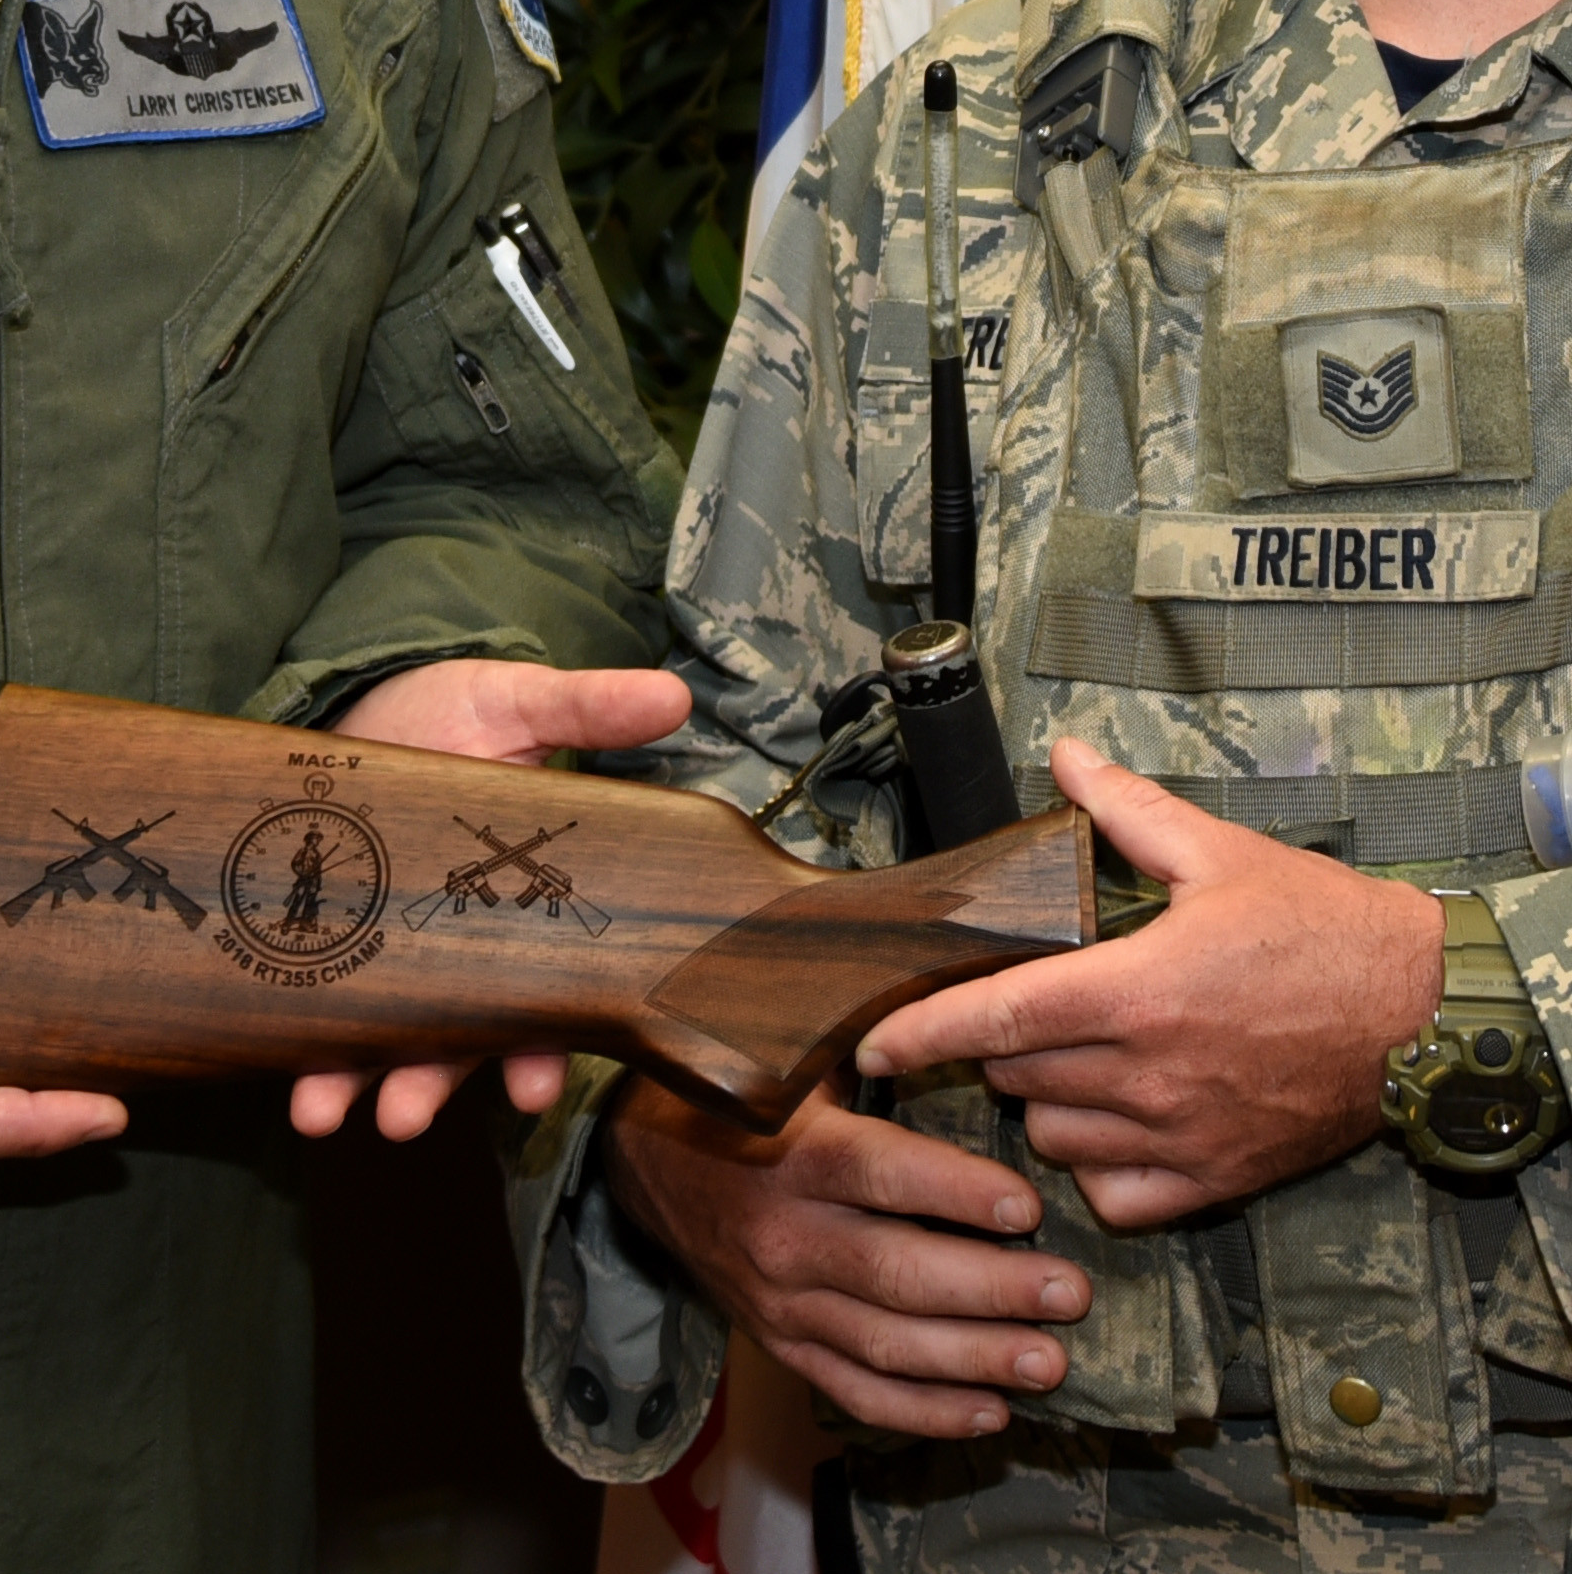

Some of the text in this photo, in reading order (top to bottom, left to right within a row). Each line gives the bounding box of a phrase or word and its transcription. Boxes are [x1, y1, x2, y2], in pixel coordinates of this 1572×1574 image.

[127, 83, 305, 117] LARRY CHRISTENSEN
[1232, 527, 1436, 591] TREIBER
[287, 752, 362, 770] MAC-V
[213, 928, 386, 988] 2018 RT355 CHAMP
[1457, 977, 1494, 986] SENSOR
